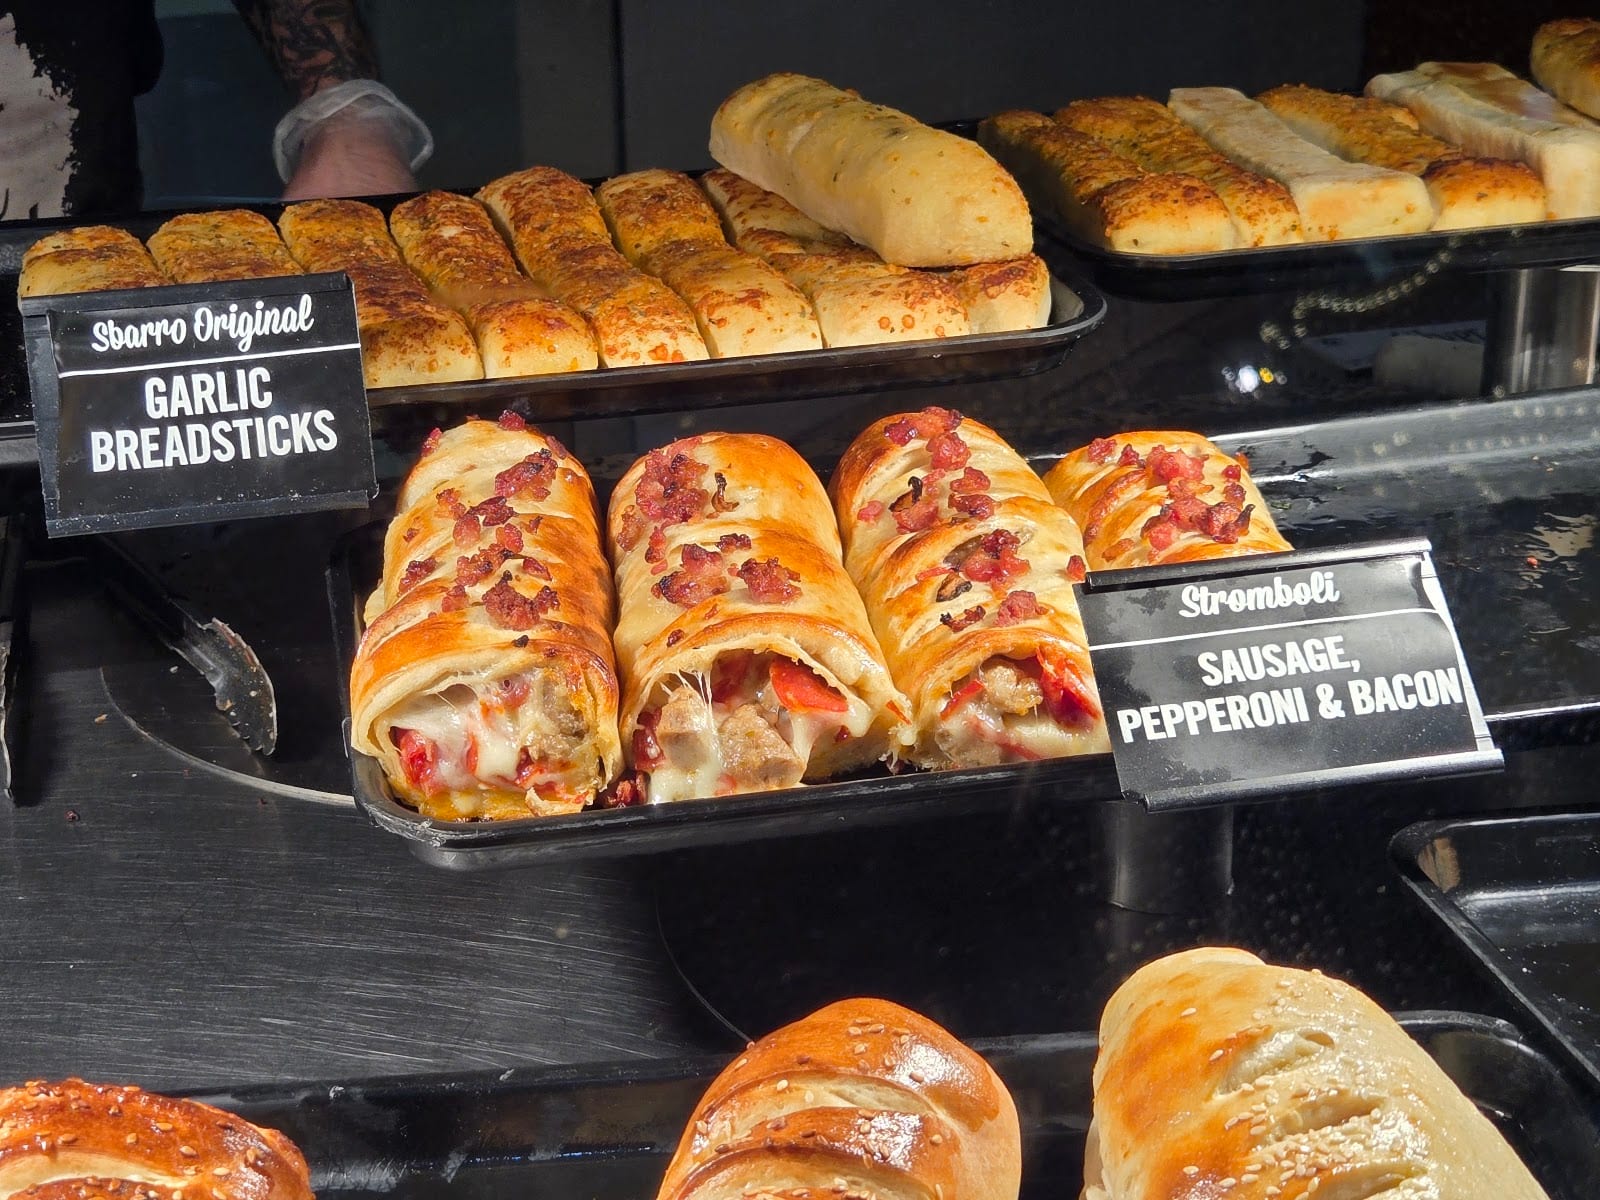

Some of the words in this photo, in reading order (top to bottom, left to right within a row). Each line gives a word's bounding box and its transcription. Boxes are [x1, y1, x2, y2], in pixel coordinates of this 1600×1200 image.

[91, 319, 187, 352] Sbarro
[194, 294, 315, 352] Original
[145, 367, 273, 419] GARLIC
[91, 410, 338, 472] BREADSTICKS
[1179, 571, 1340, 618] Stromboli
[1198, 635, 1360, 687] SAUSAGE,
[1116, 687, 1310, 743] PEPPERONI
[1316, 683, 1346, 719] &
[1348, 667, 1464, 716] BACON
